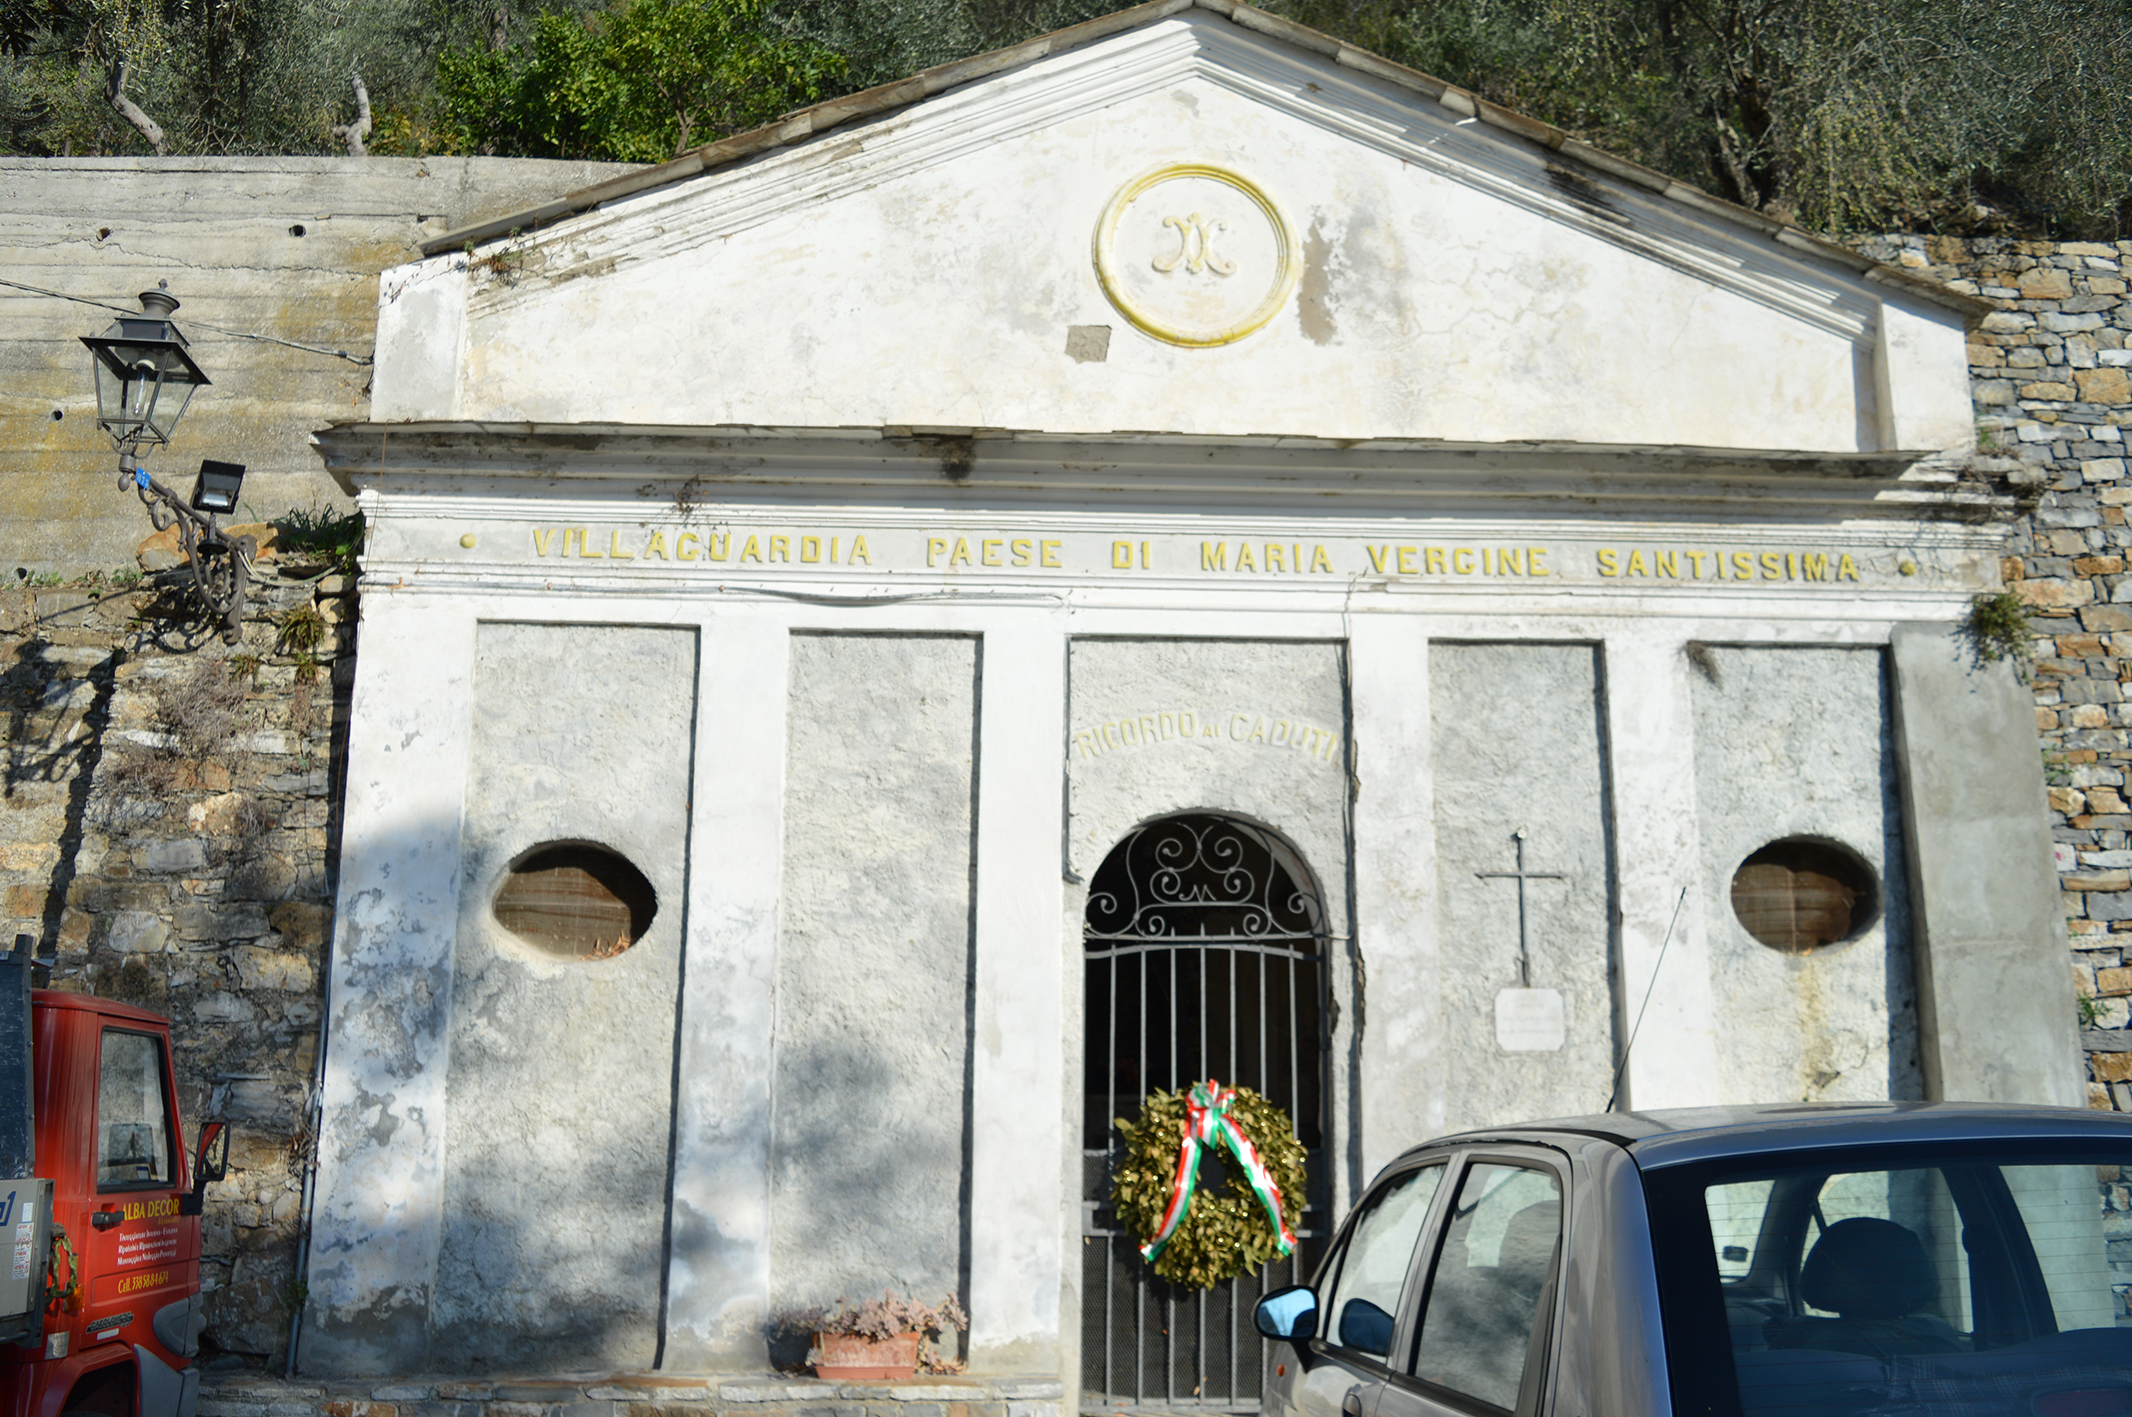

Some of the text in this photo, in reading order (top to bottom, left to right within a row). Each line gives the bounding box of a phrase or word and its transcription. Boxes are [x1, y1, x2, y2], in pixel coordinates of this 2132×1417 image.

[533, 528, 1860, 582] VILLAGUARDIA PAESE DI MARIA VERGINE SANTISSIMA
[1075, 710, 1197, 759] RICORDO
[1229, 712, 1339, 762] CADUTI
[123, 1202, 146, 1221] ALBA
[147, 1198, 180, 1218] DECOR
